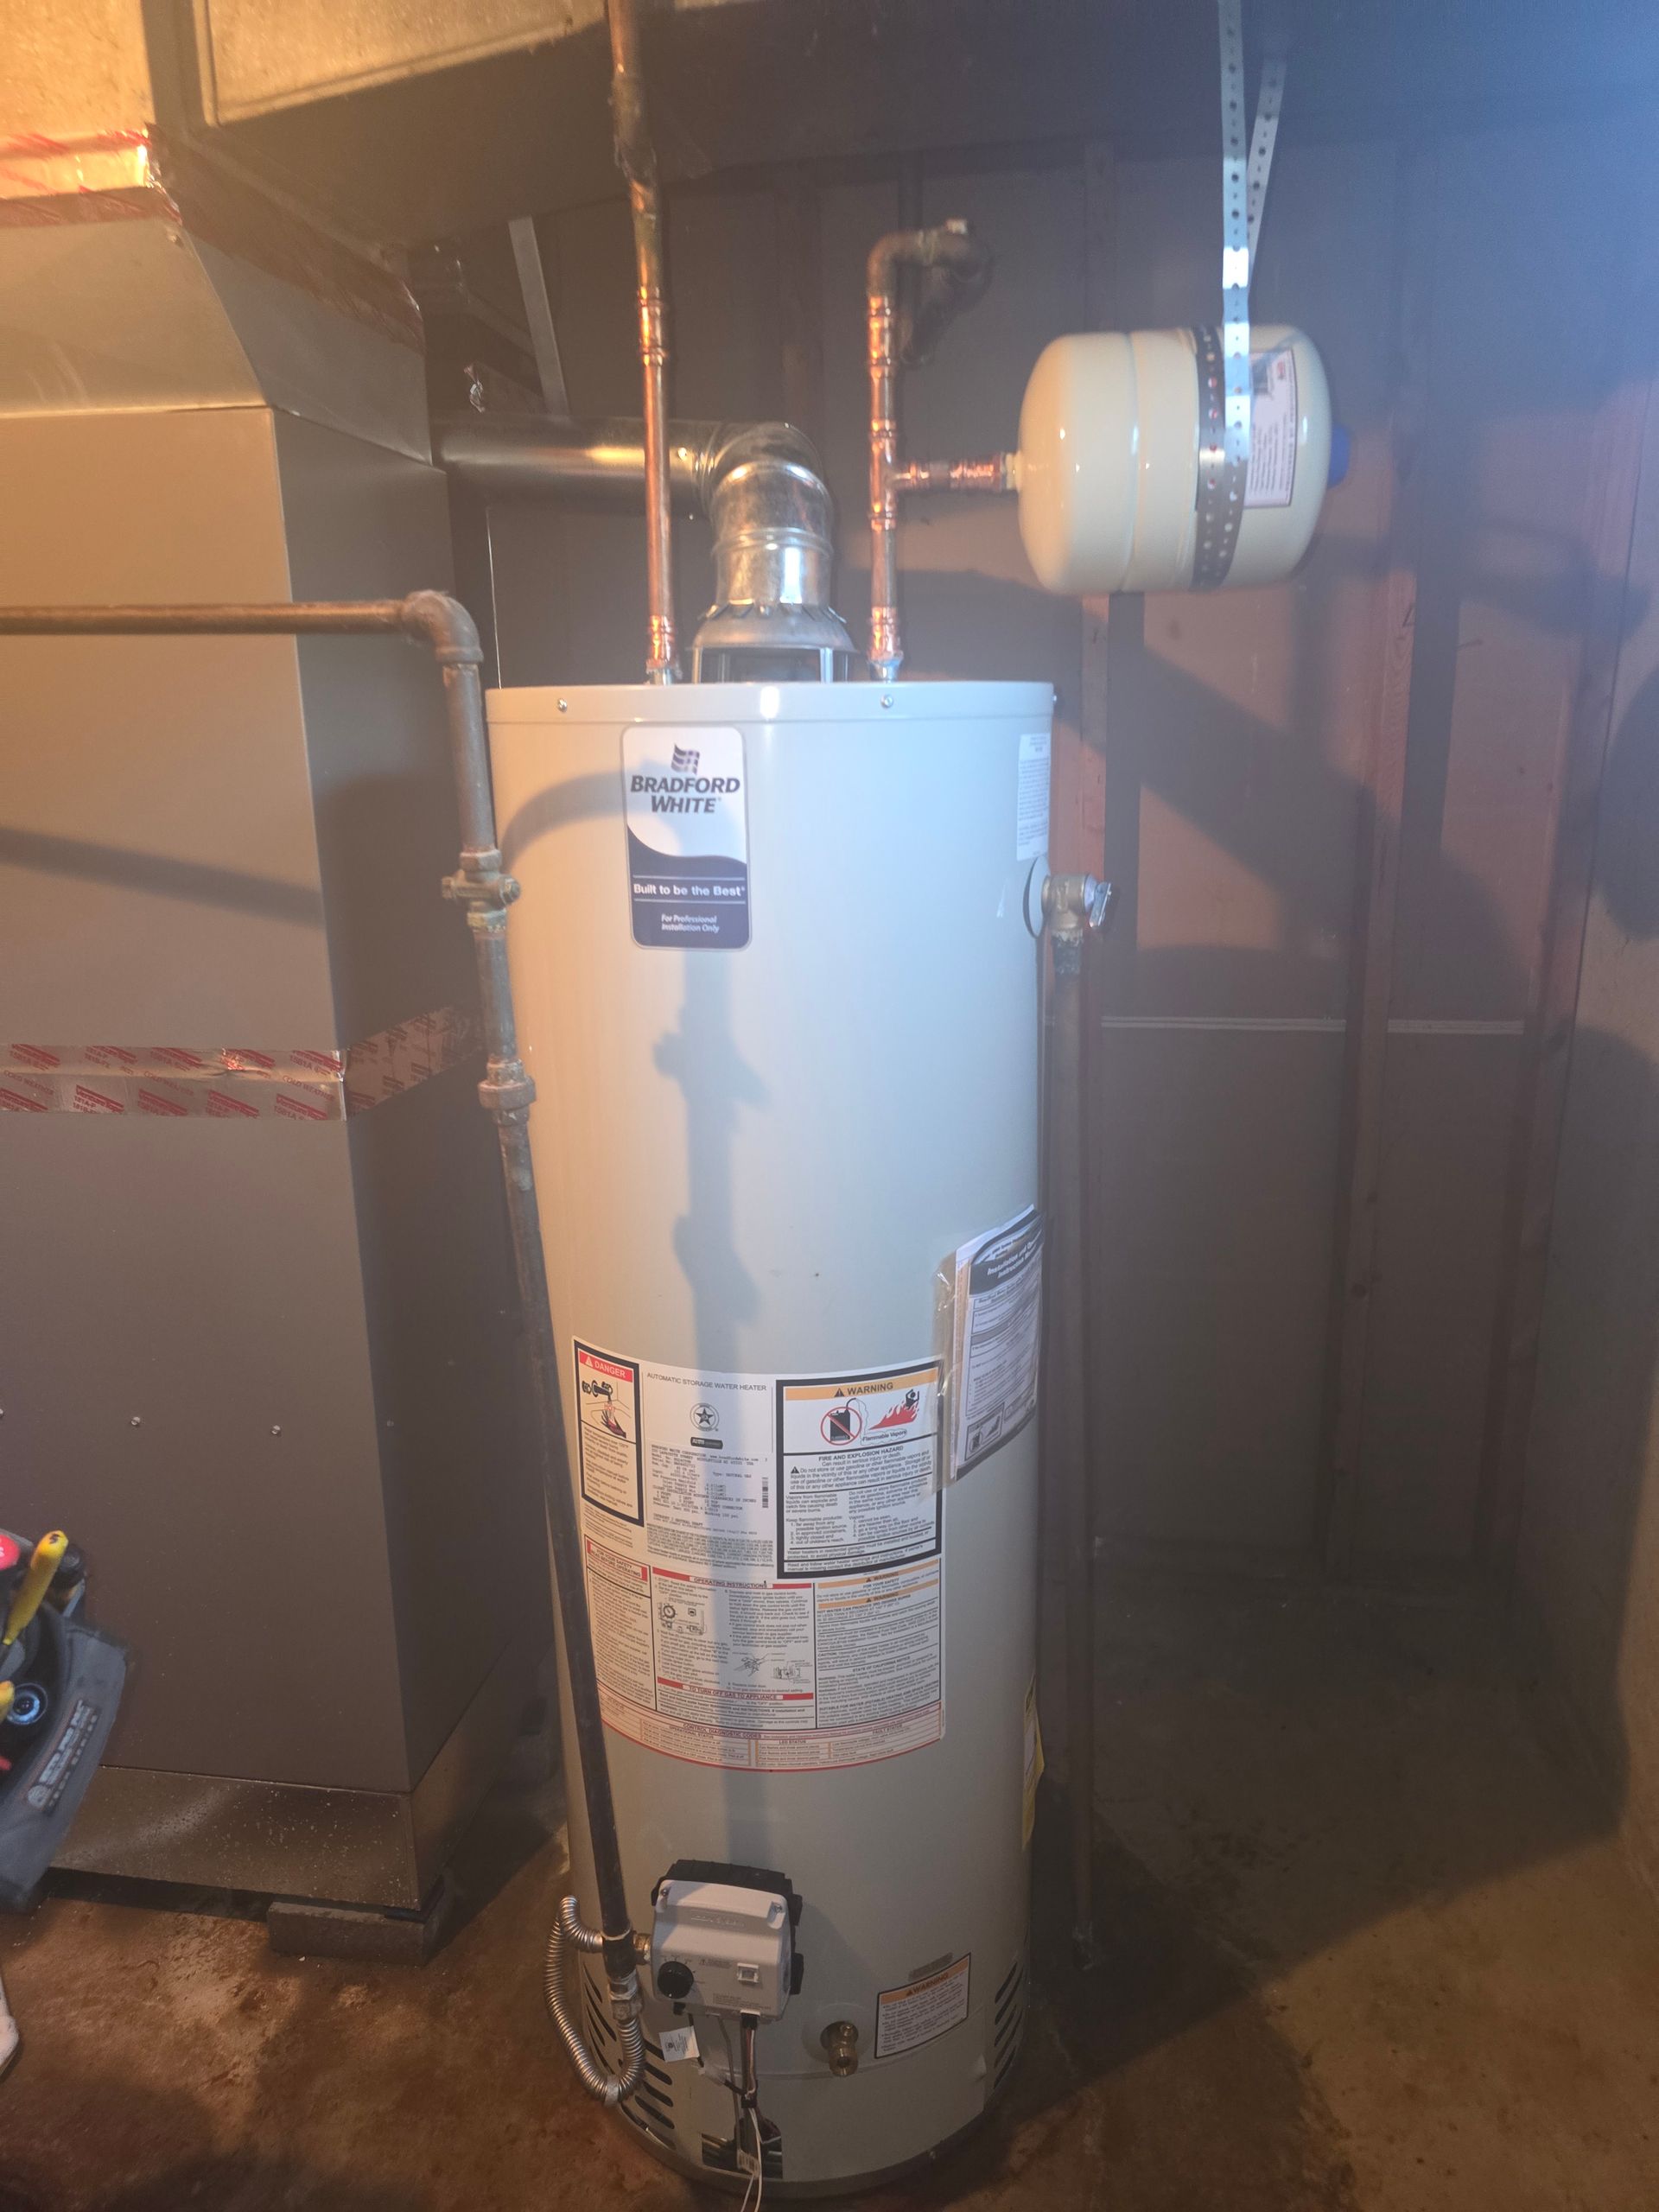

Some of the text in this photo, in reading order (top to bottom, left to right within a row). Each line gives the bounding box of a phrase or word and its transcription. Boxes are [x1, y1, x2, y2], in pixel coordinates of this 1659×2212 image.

[631, 774, 741, 794] BRADFORD
[651, 795, 717, 814] WHITE
[633, 883, 657, 895] Built
[659, 885, 671, 895] to
[673, 885, 689, 896] be
[691, 886, 710, 896] the
[661, 914, 717, 924] For Professional
[661, 924, 720, 934] Installation Only
[283, 1075, 335, 1102] COLD WEATHER
[594, 1360, 626, 1379] DANGER
[646, 1372, 682, 1384] AUTOMATIC
[682, 1377, 714, 1389] STORAGE
[715, 1382, 739, 1390] WATER
[847, 1382, 894, 1396] WARNING
[848, 1450, 880, 1459] EXPLOSION
[881, 1446, 904, 1454] HAZARD
[693, 1577, 726, 1587] OPERATING
